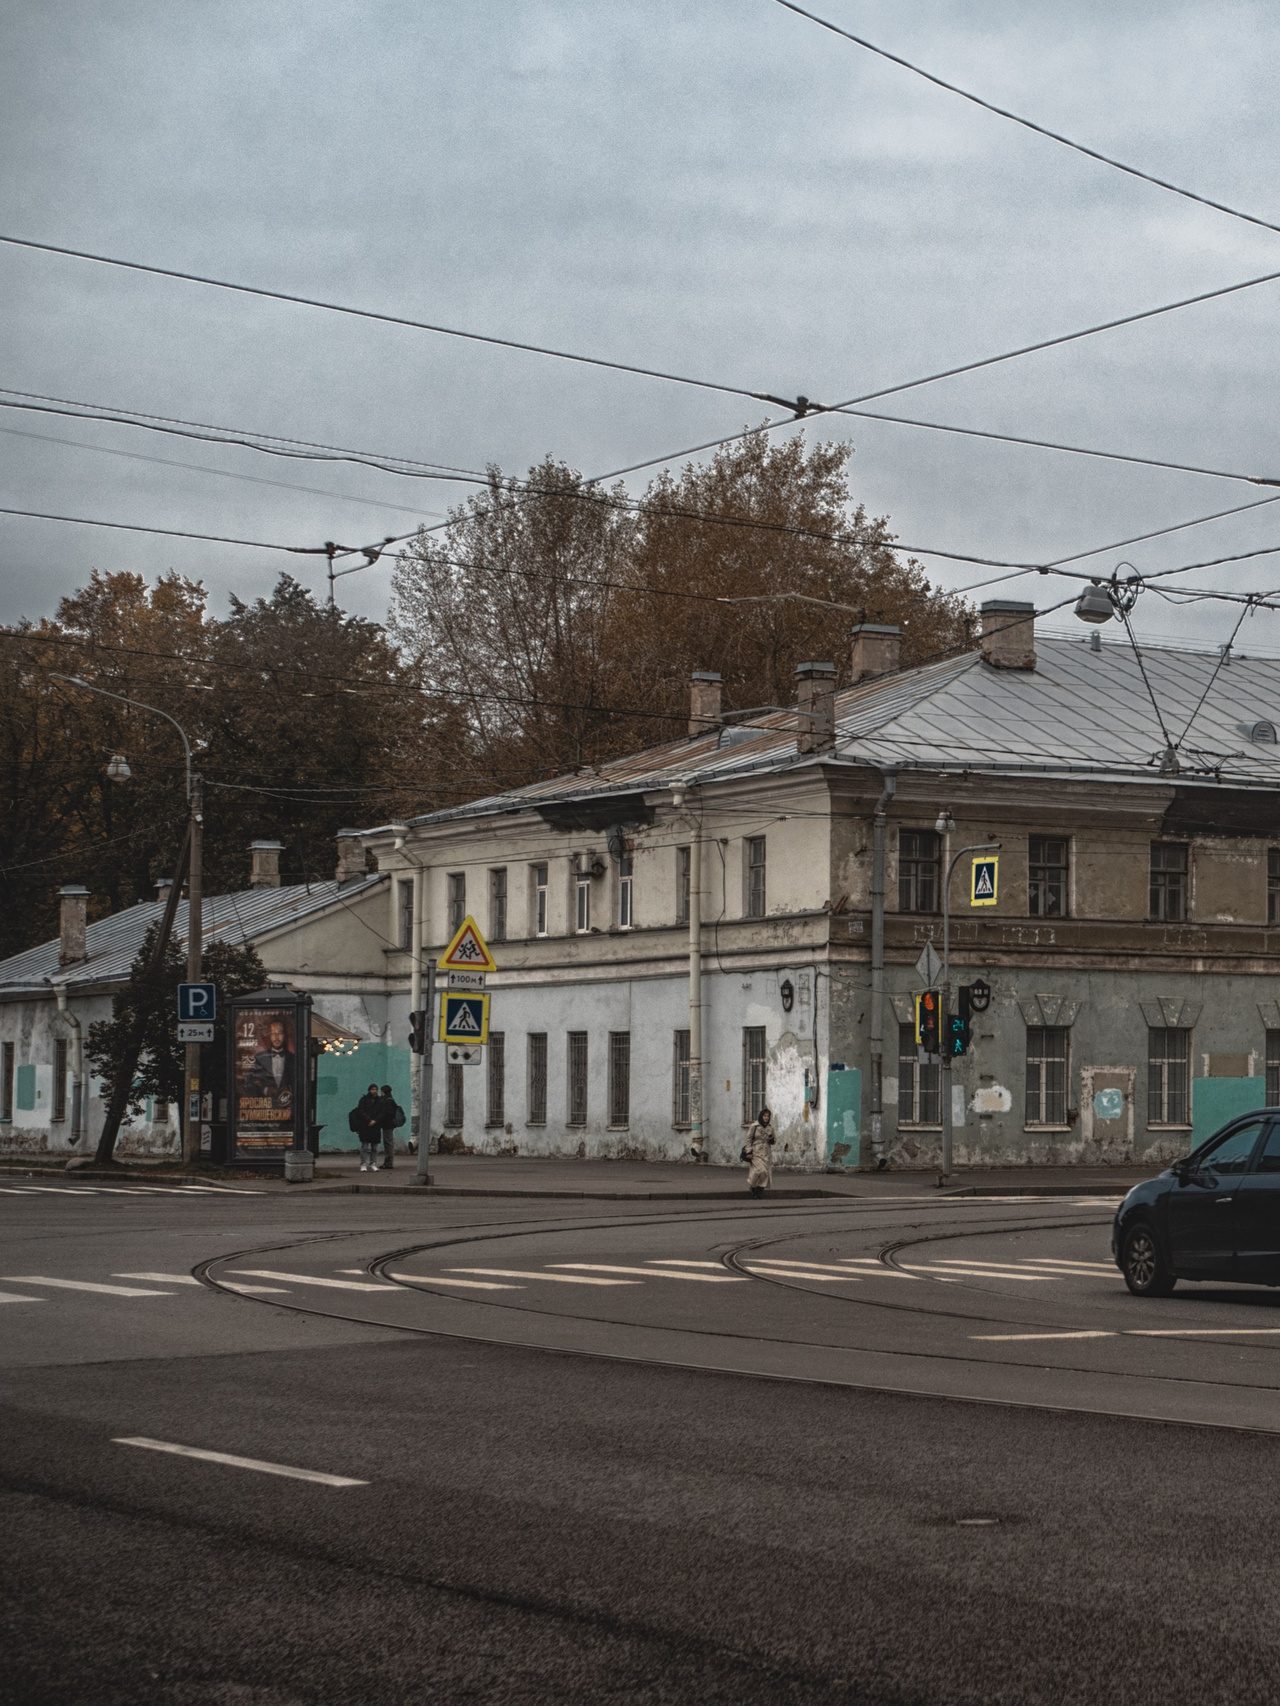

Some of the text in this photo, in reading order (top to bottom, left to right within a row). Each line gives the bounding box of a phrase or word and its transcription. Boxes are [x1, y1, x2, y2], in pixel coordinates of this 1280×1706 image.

[188, 988, 209, 1017] P
[242, 1022, 255, 1038] 12
[952, 1019, 965, 1032] 24
[239, 1096, 273, 1109] ЯРОСЛАВ
[239, 1107, 291, 1121] СУМИШЕВСКИЙ
